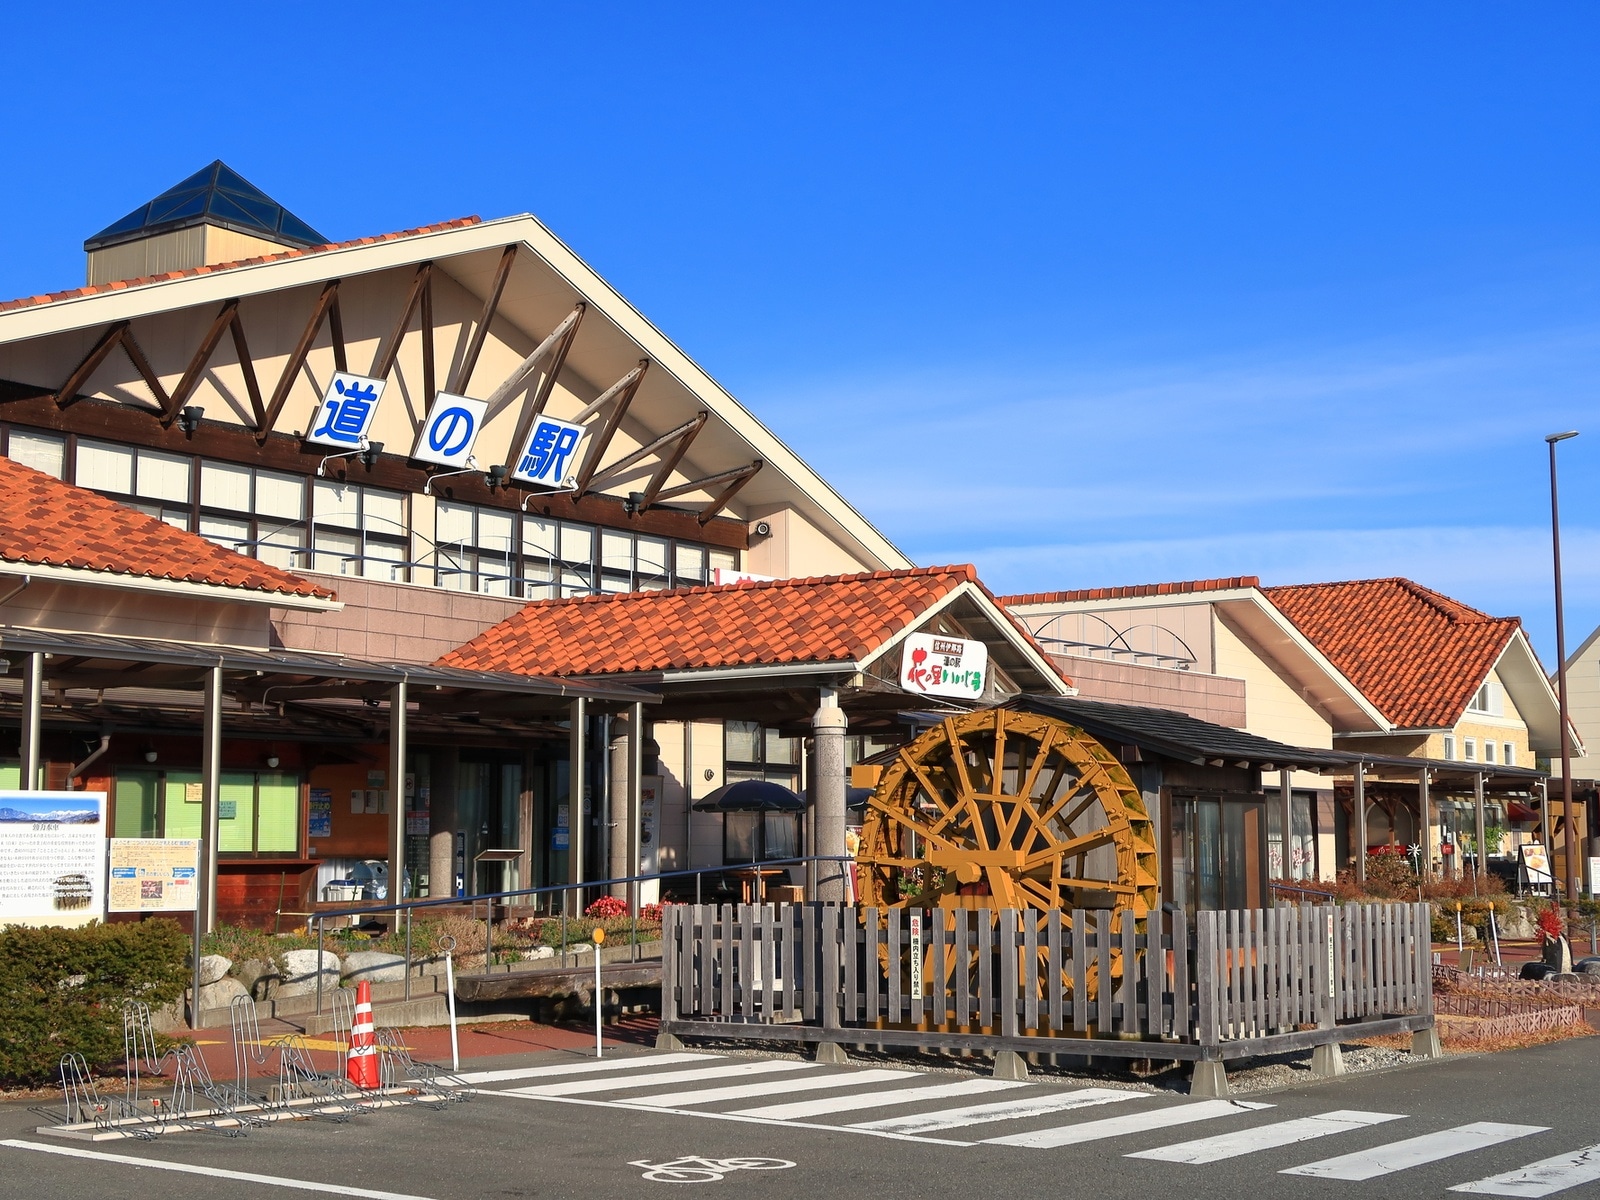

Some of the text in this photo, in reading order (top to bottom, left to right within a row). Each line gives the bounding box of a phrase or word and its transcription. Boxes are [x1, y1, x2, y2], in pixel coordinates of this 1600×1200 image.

[315, 379, 579, 482] 道の駅
[943, 656, 961, 668] 道の駅
[912, 919, 919, 936] 危険
